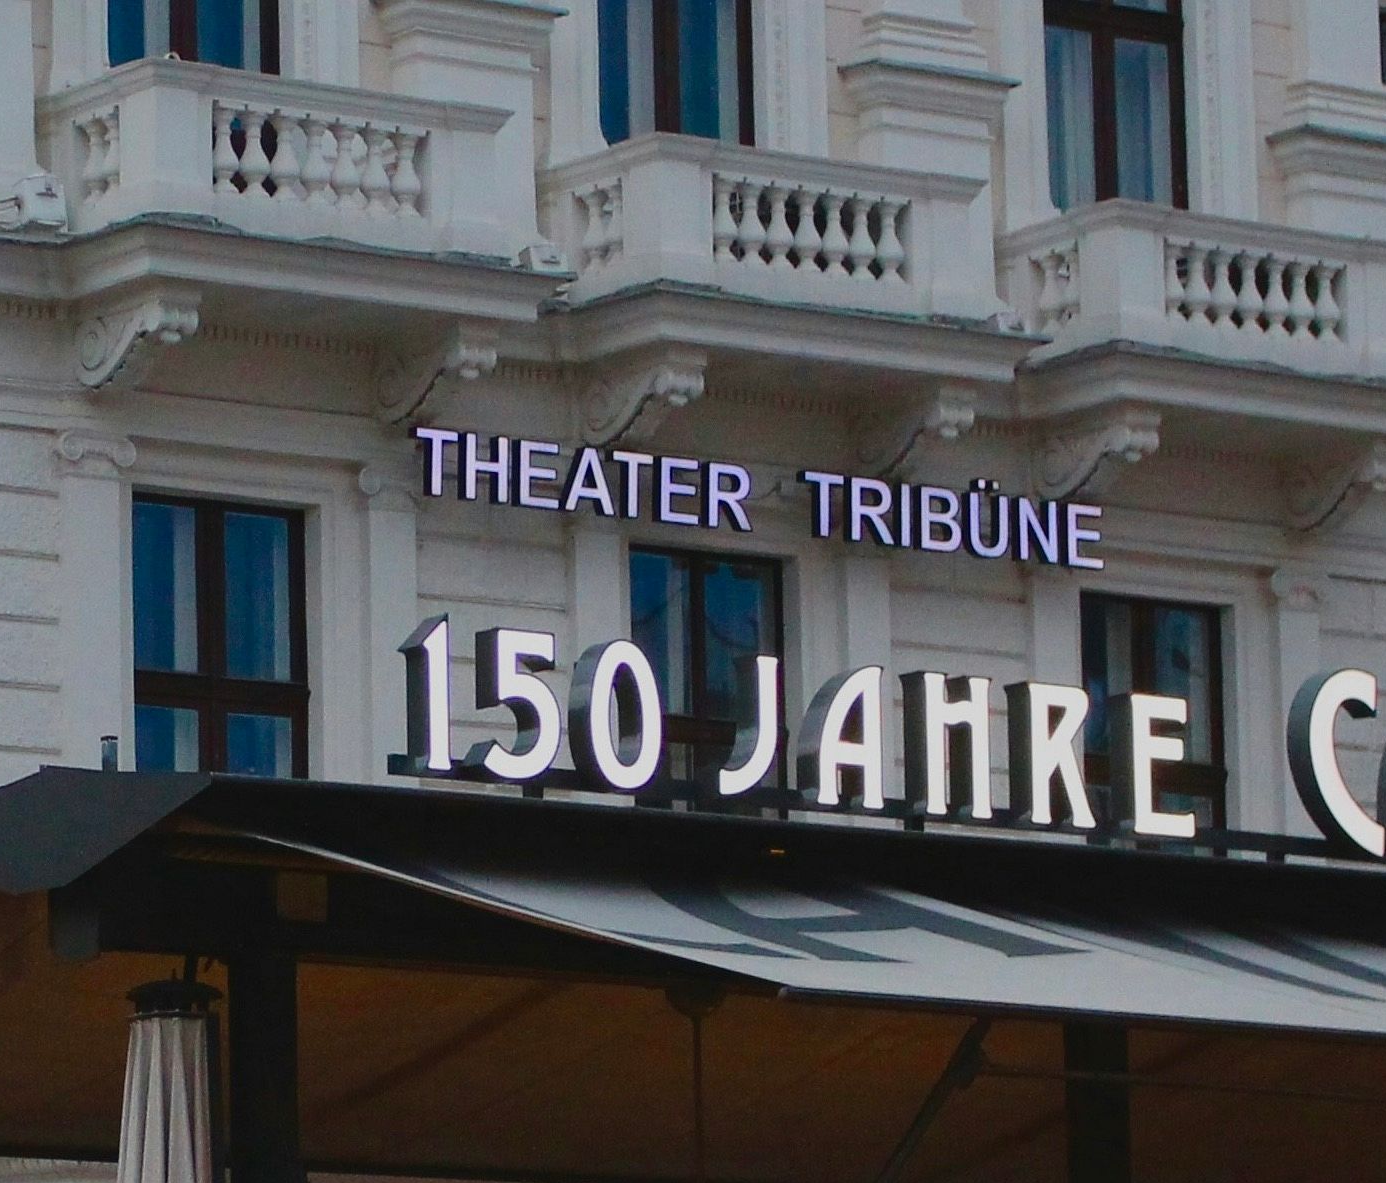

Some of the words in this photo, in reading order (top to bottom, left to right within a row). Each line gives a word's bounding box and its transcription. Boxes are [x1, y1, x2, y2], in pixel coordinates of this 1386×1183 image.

[416, 427, 752, 531] THEATER
[803, 470, 1105, 569] TRIBÜNE
[404, 616, 663, 790] 150
[718, 654, 1196, 838] JAHRE
